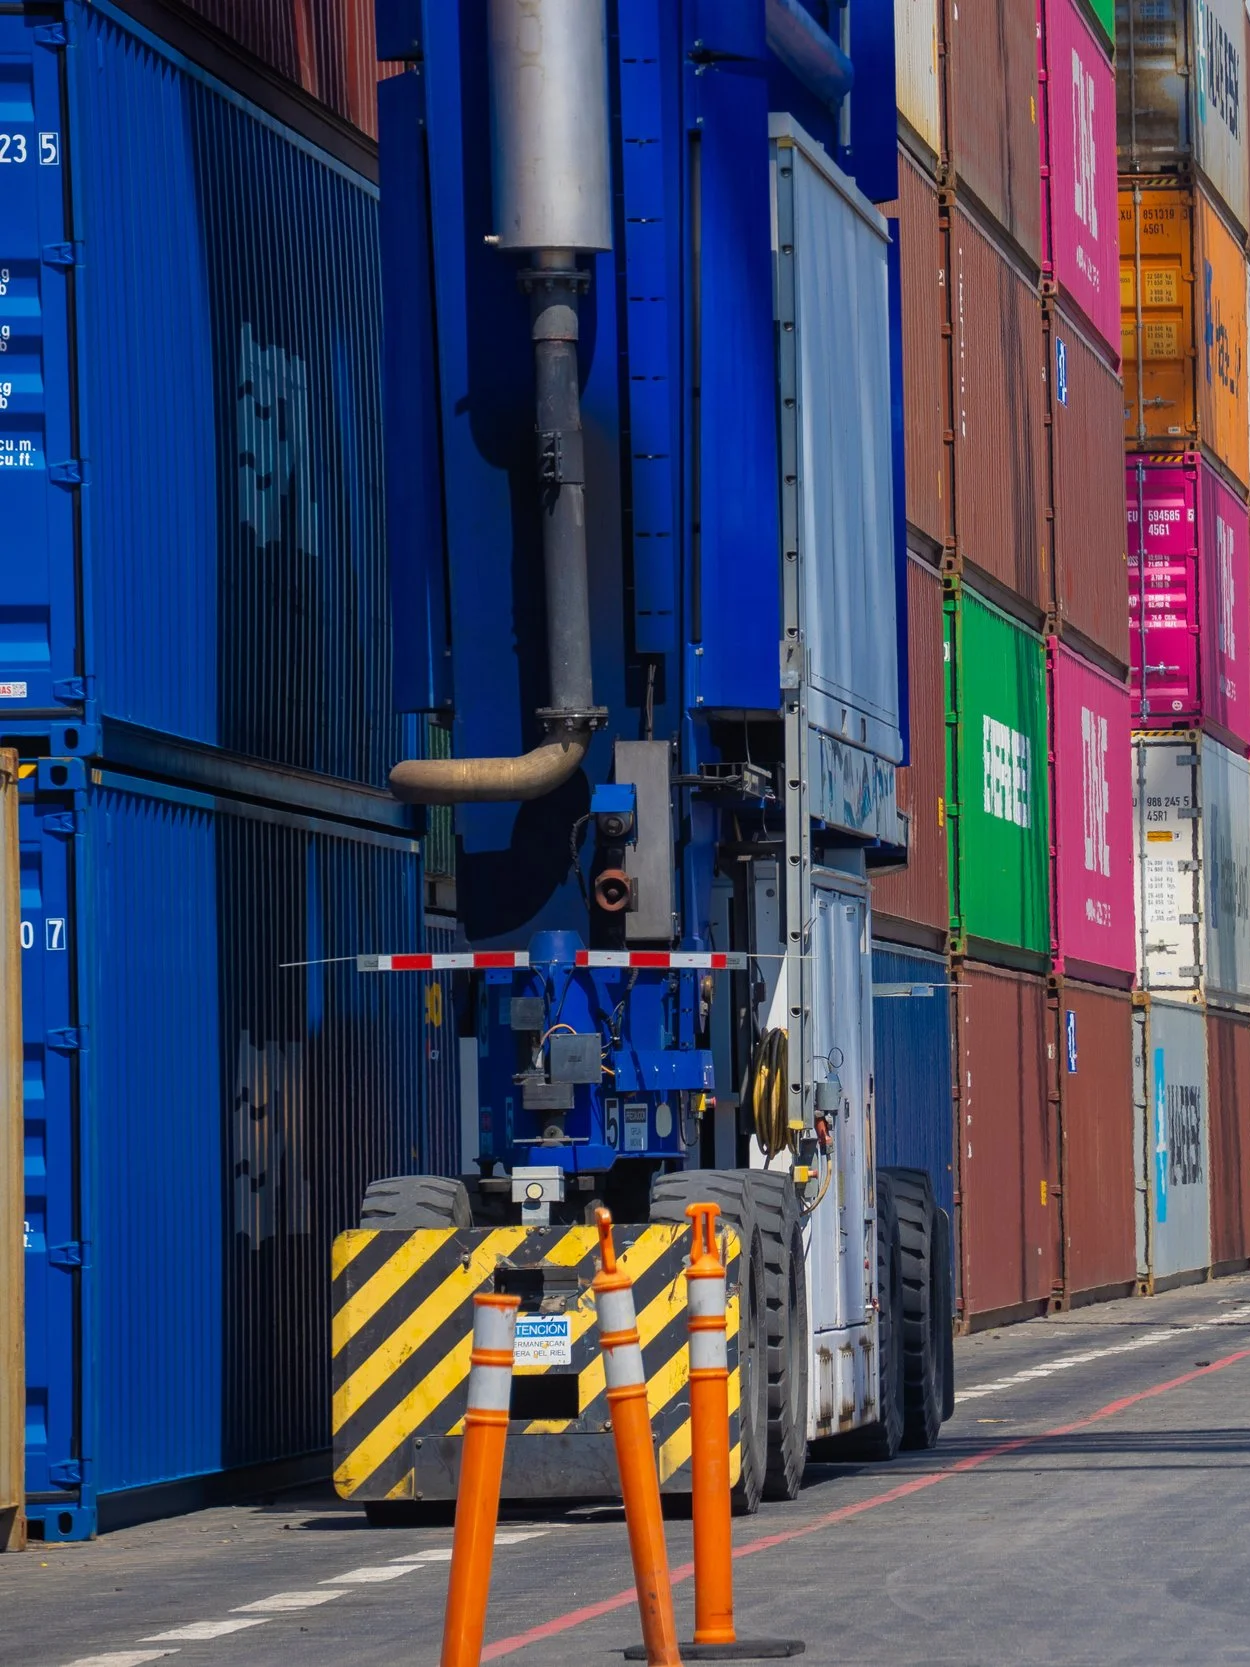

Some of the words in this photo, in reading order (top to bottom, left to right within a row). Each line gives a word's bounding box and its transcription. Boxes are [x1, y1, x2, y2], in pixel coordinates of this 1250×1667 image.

[42, 134, 56, 163] 5
[1118, 210, 1131, 220] XU
[1148, 510, 1180, 521] 594585
[1149, 524, 1169, 535] 45G1
[1082, 705, 1110, 879] ONE
[1147, 797, 1161, 807] 988
[1165, 797, 1180, 807] 245
[1147, 811, 1167, 821] 45R1
[48, 920, 63, 948] 7
[550, 1349, 566, 1357] RIEL
